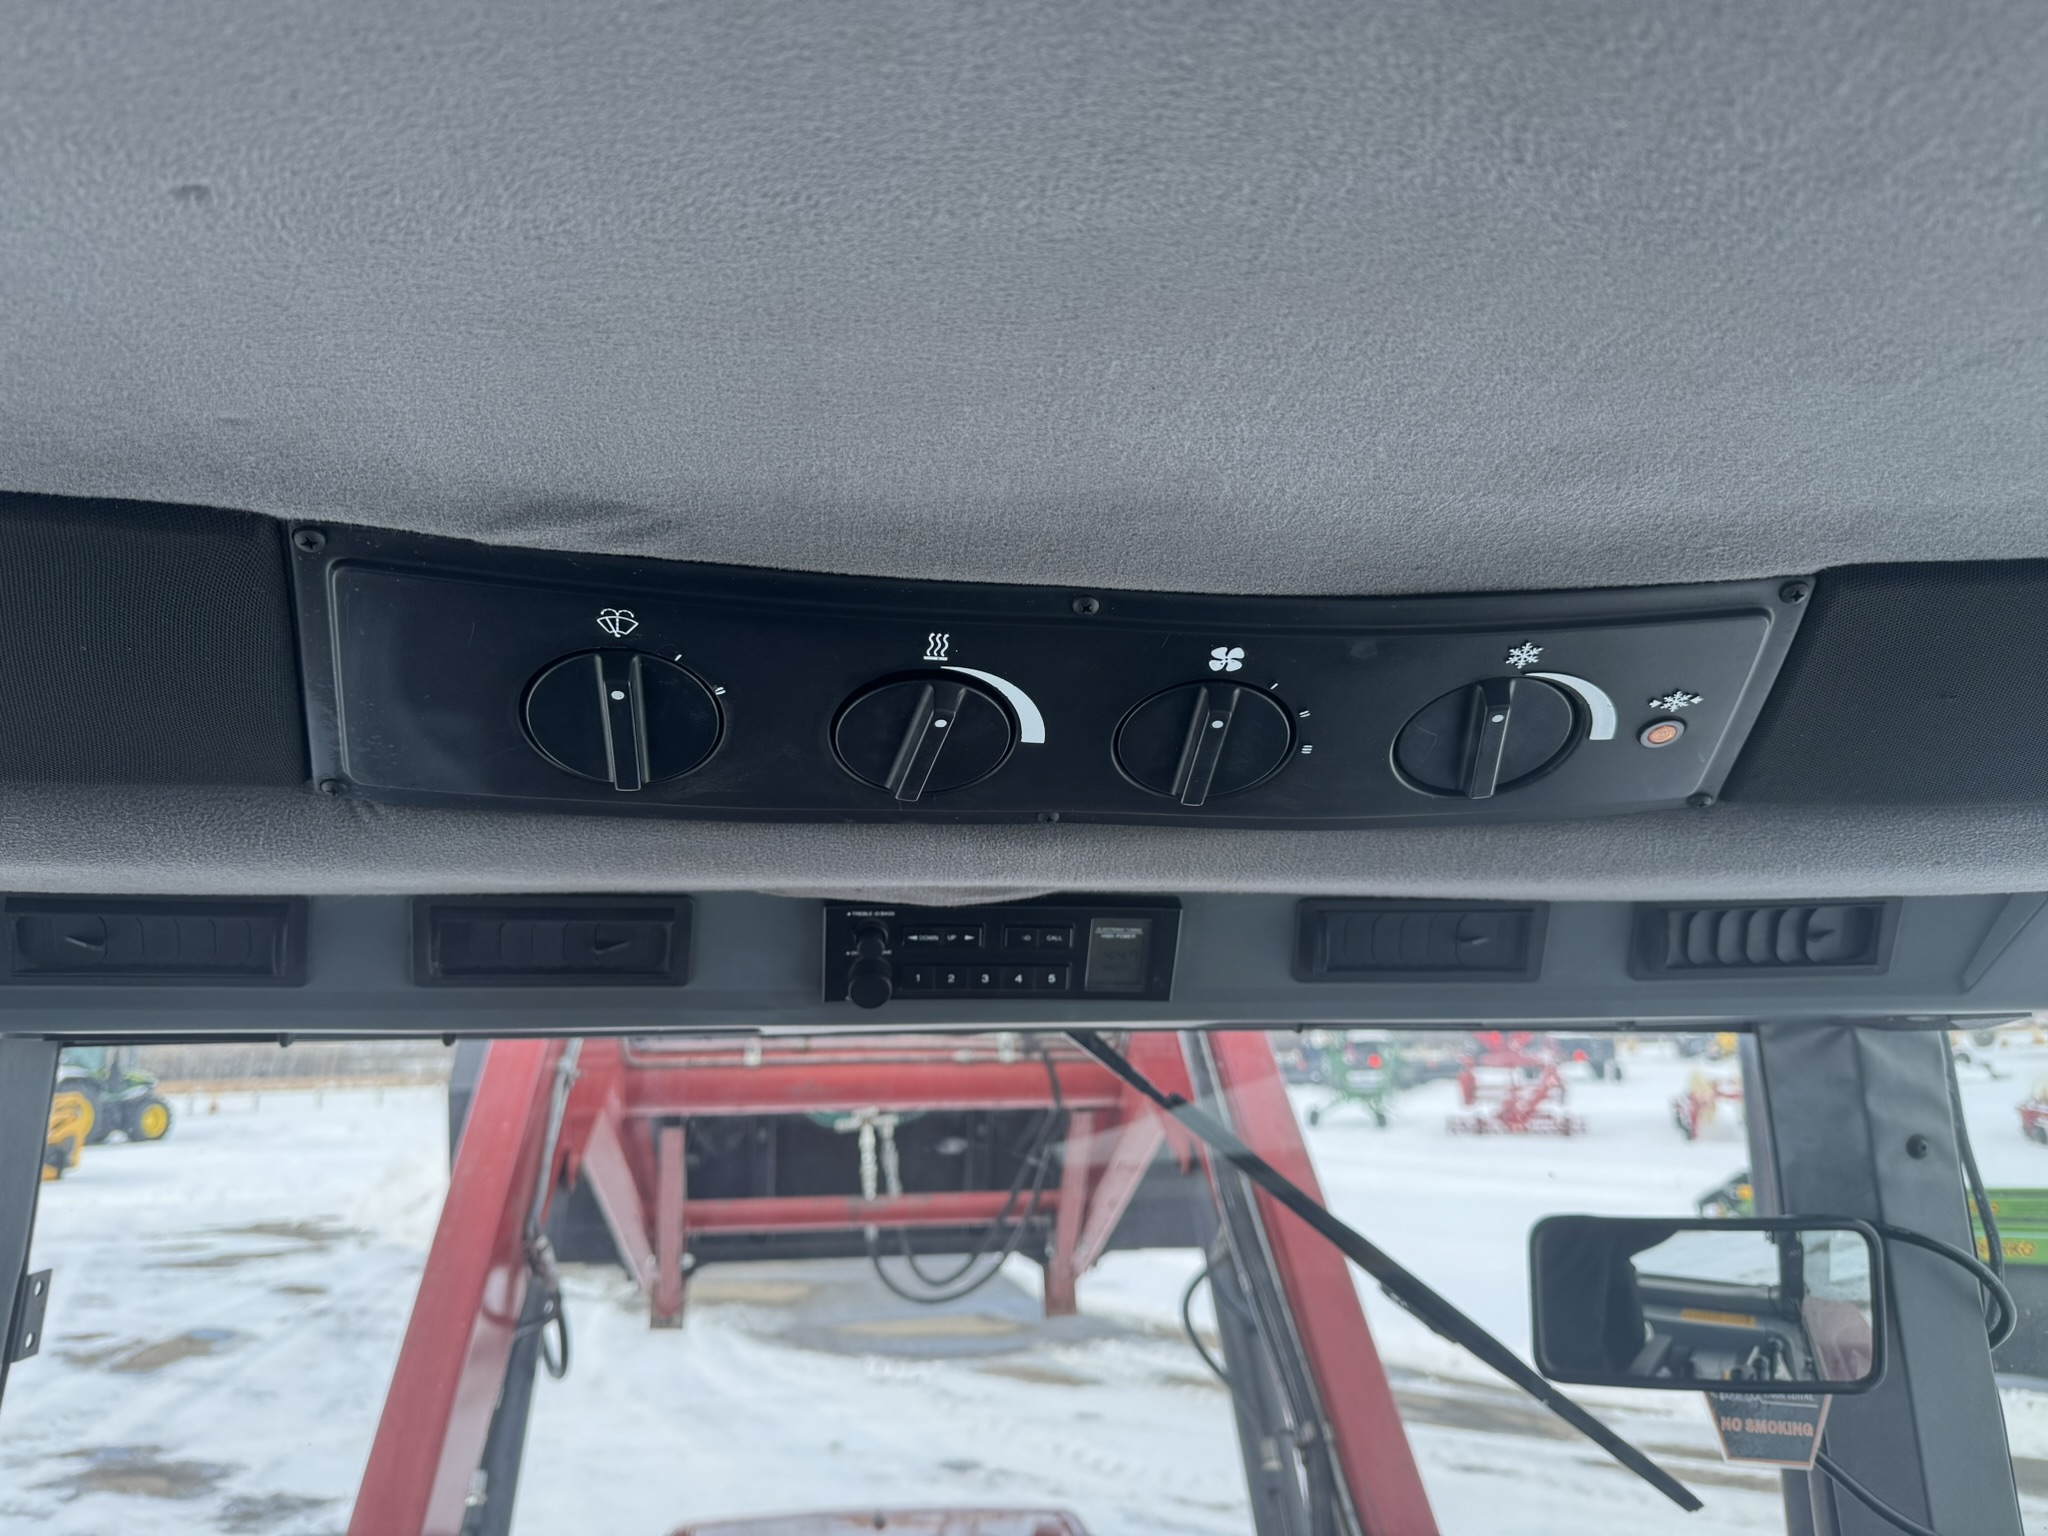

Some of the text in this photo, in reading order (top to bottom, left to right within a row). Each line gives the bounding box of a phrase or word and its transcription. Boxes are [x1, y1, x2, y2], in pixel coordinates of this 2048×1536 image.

[916, 974, 920, 982] 1
[947, 974, 955, 983] 2
[981, 974, 989, 983] 3
[1014, 974, 1022, 983] 4
[1048, 974, 1056, 983] 5
[1720, 1416, 1813, 1437] NO SMOKING
